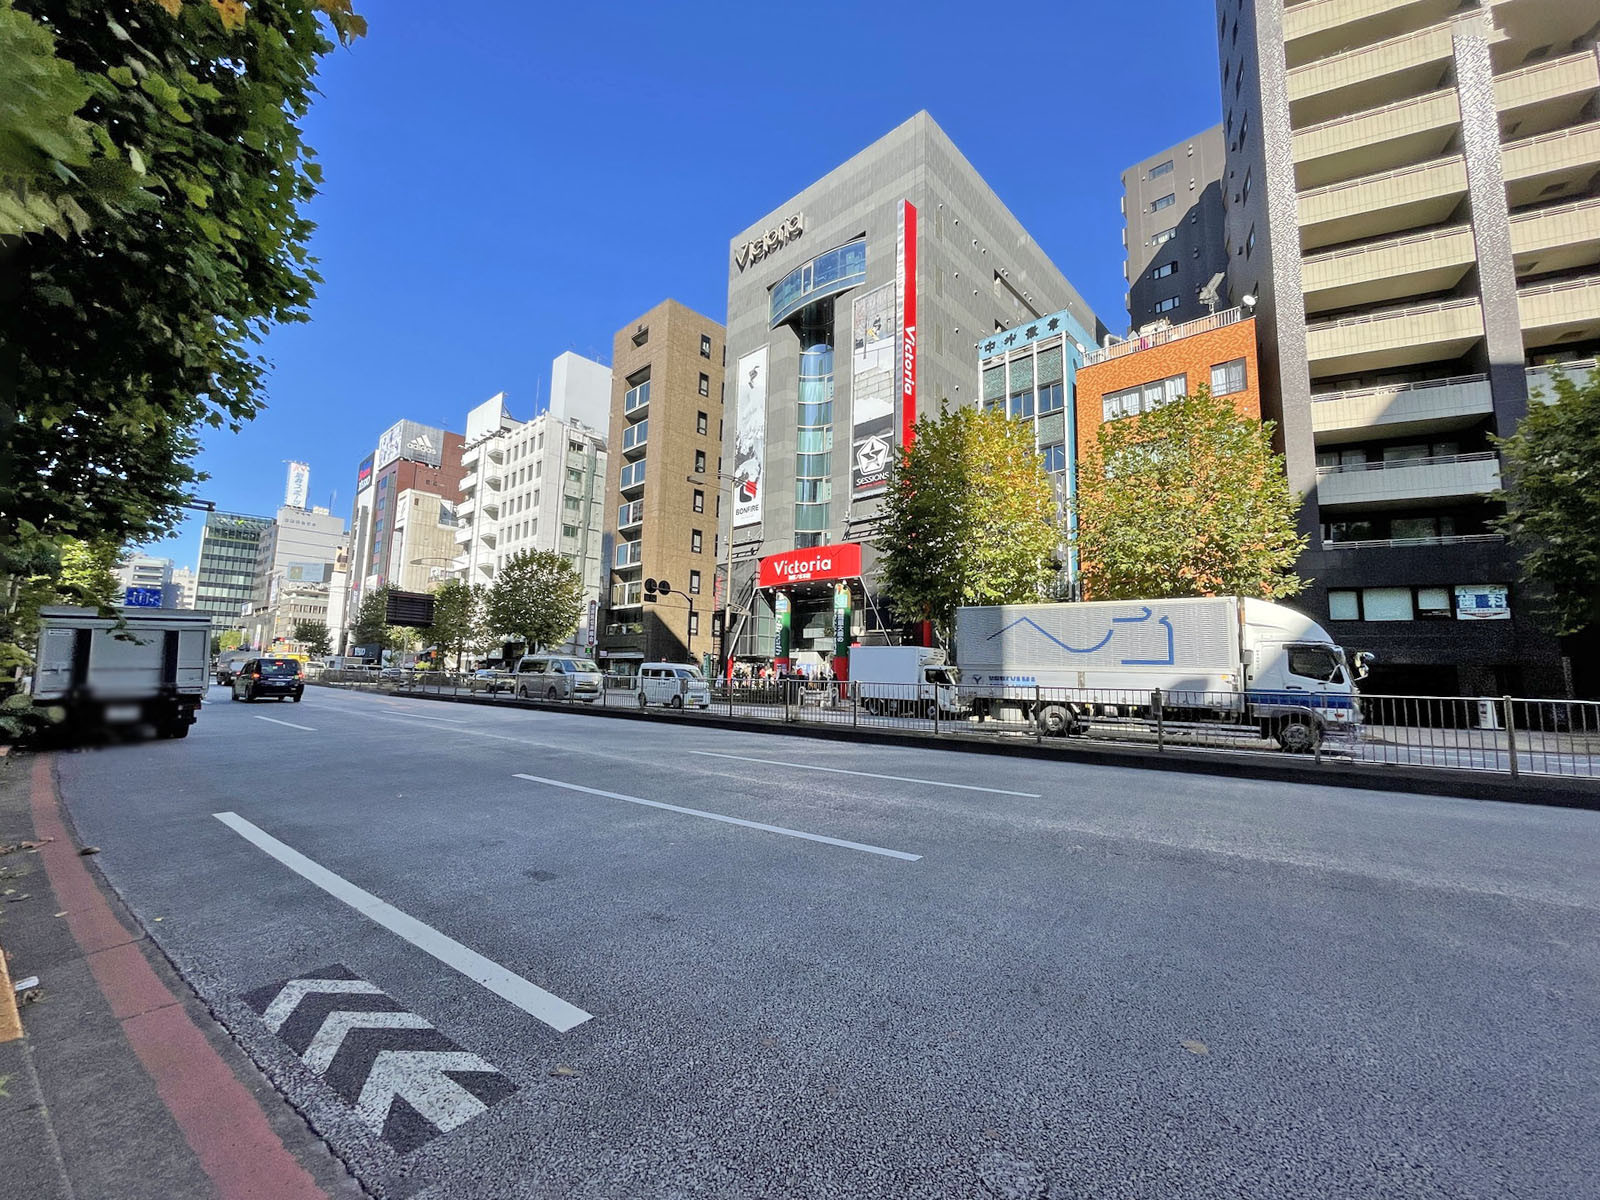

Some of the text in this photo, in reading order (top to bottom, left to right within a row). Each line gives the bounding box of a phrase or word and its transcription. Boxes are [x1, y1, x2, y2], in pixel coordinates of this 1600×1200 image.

[735, 211, 804, 272] Victoria
[904, 326, 917, 396] Victoria
[406, 442, 437, 455] adidas
[855, 471, 890, 486] SESSIONS
[735, 504, 760, 516] BONFIRE
[773, 555, 832, 577] Victoria
